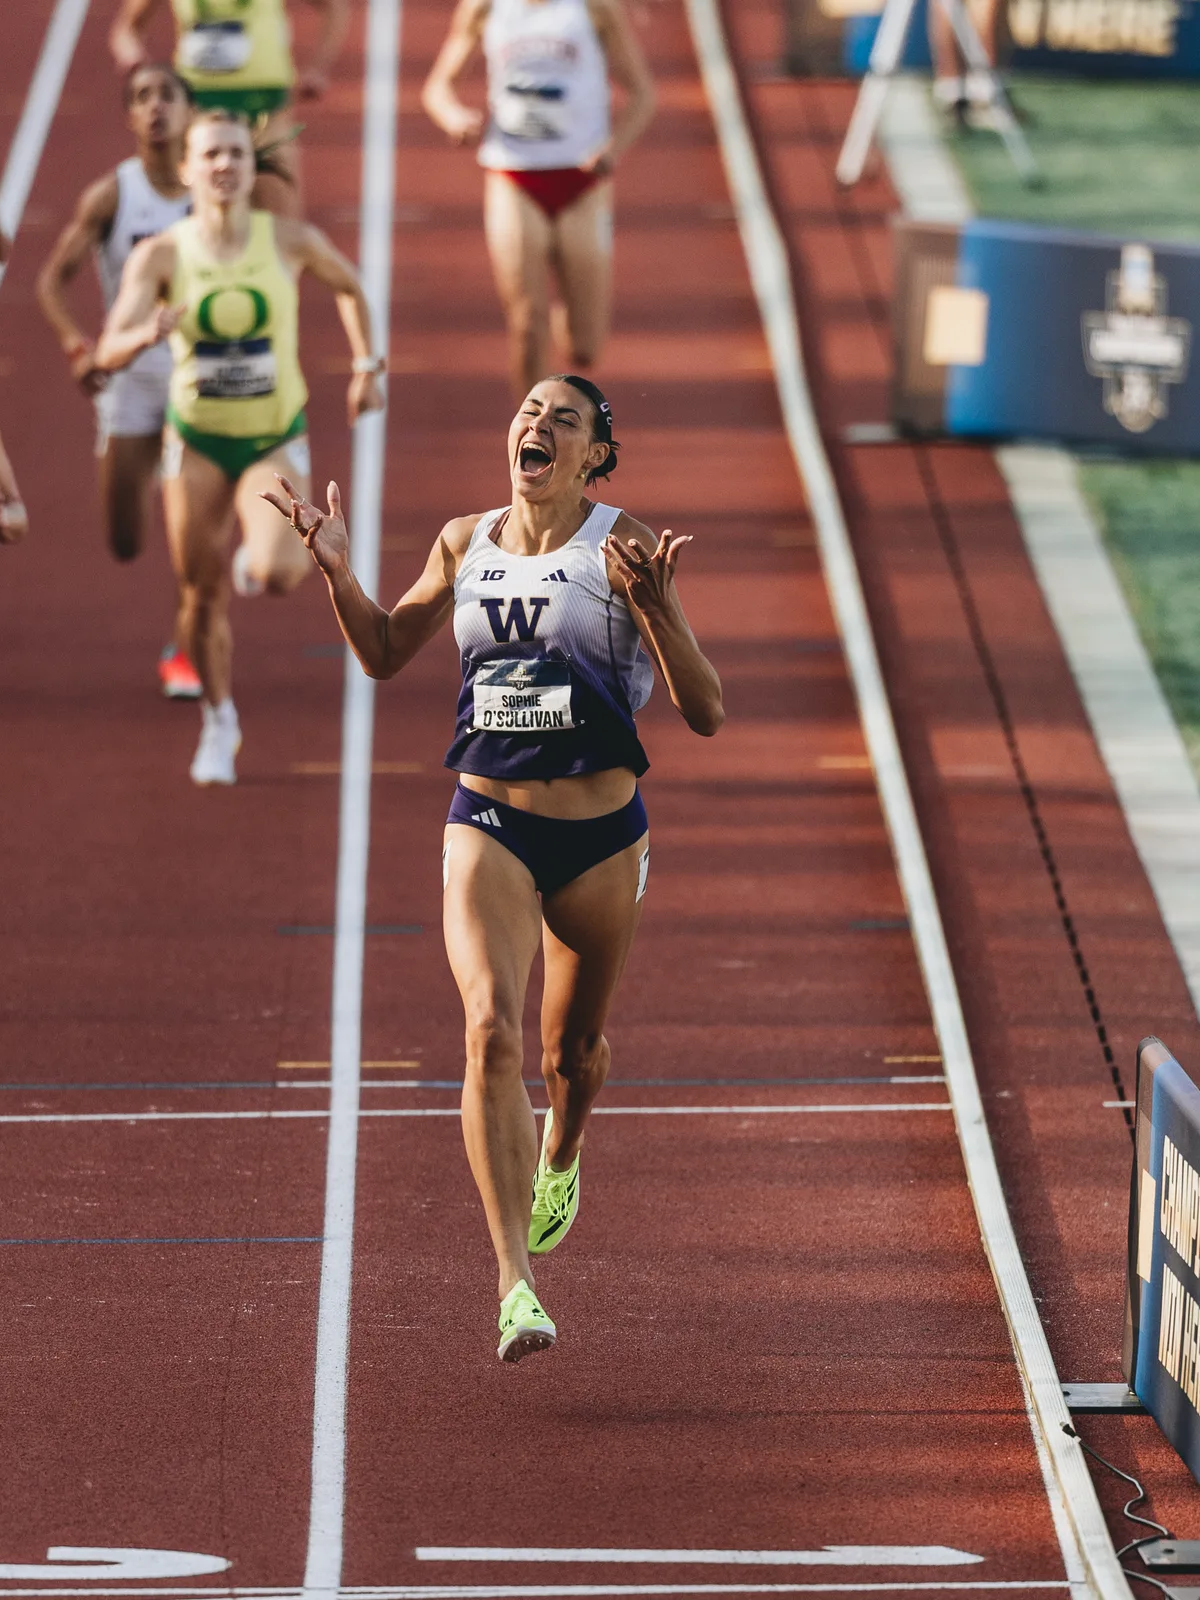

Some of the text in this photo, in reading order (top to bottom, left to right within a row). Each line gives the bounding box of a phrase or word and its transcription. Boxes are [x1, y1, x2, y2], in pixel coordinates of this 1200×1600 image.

[198, 284, 268, 341] O
[480, 597, 550, 643] W
[502, 694, 541, 708] SOPHIE
[483, 710, 564, 728] O'SULLIVAN
